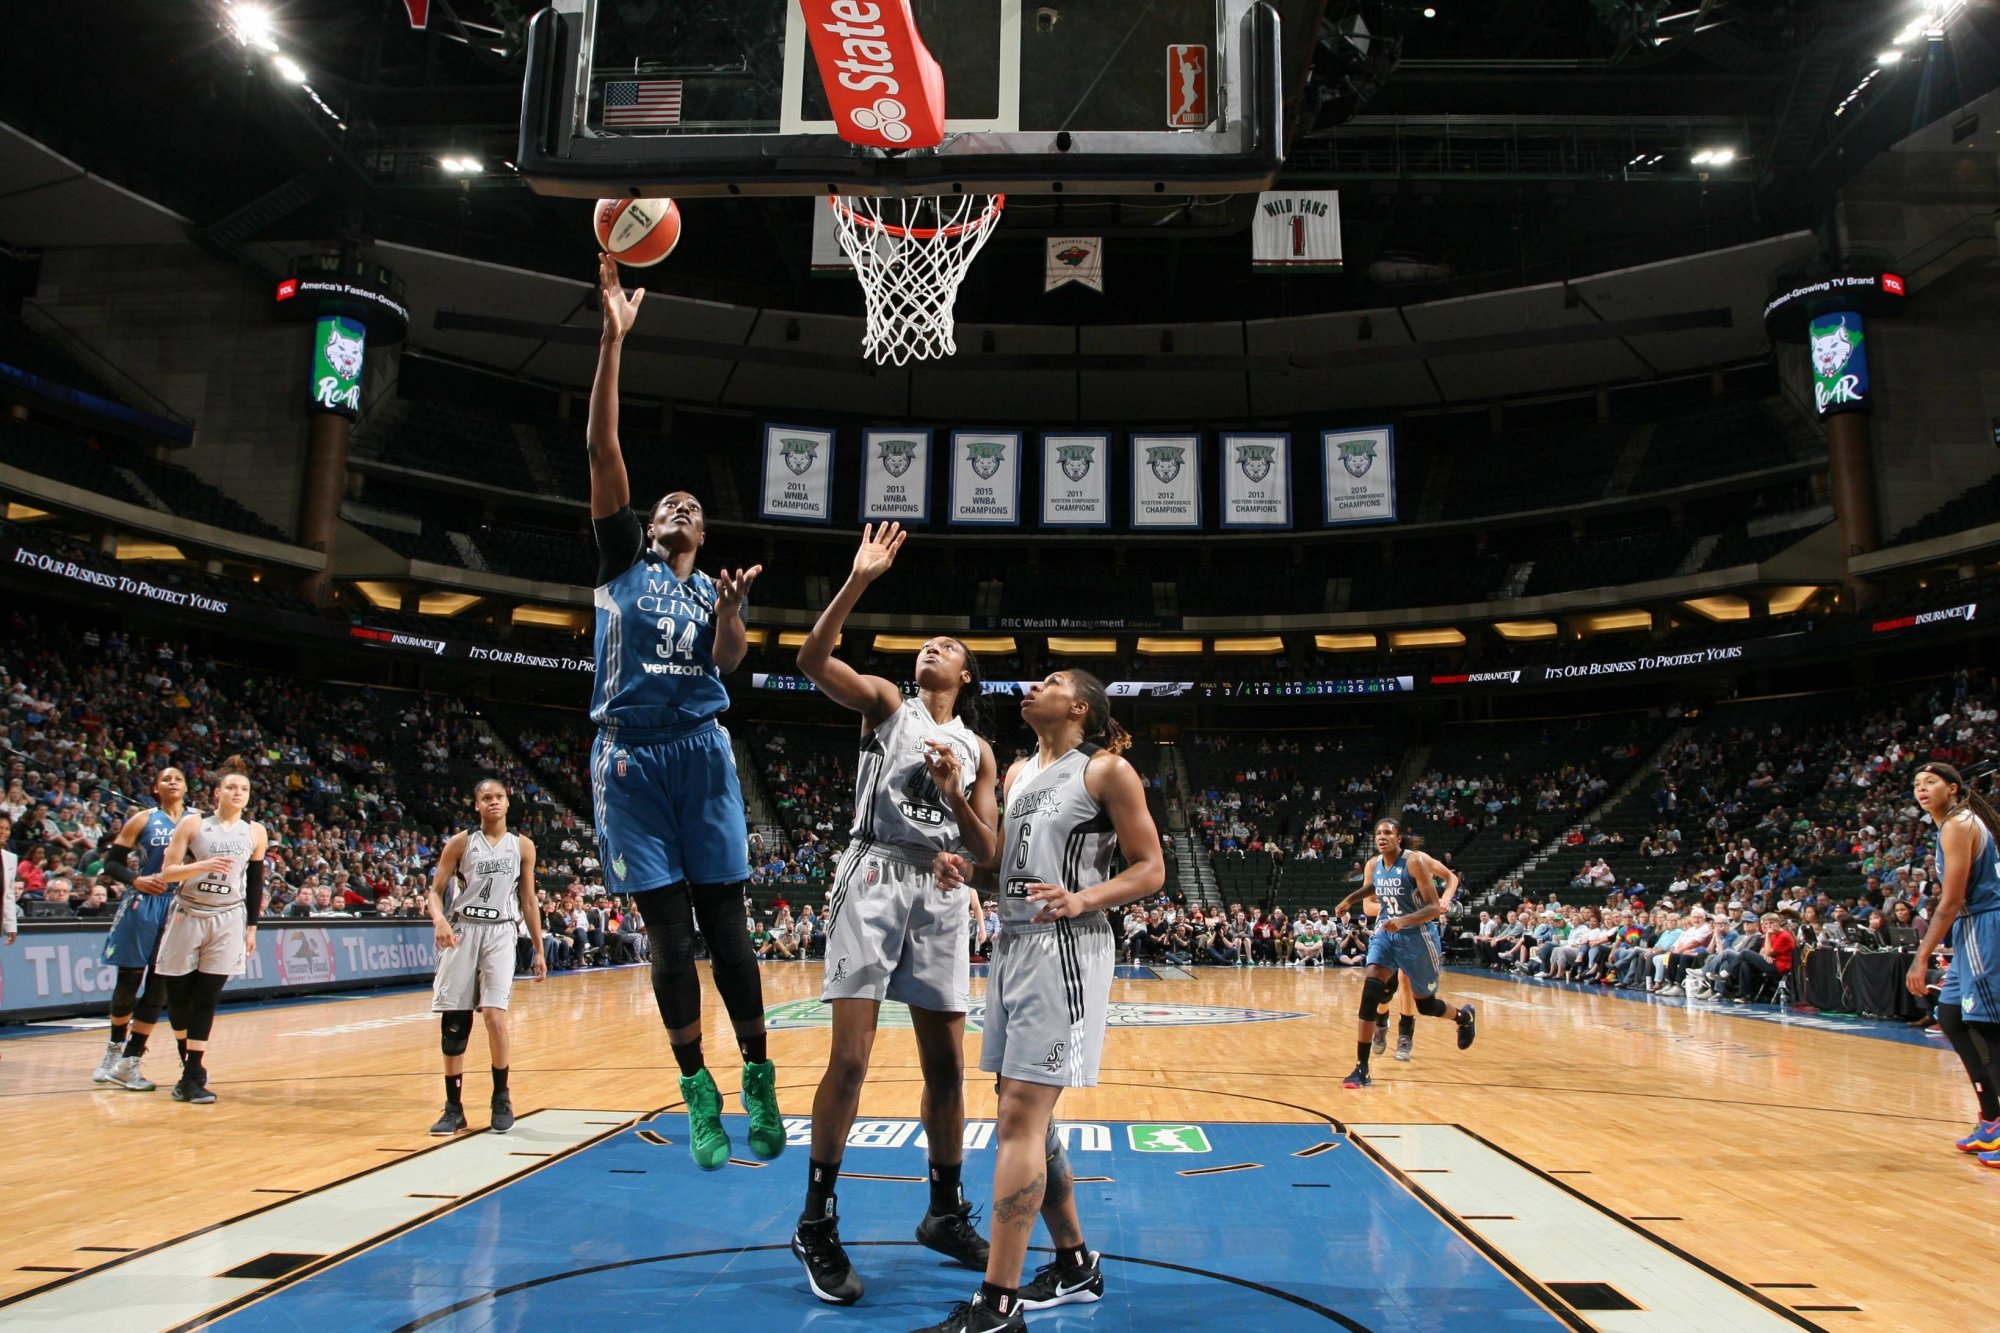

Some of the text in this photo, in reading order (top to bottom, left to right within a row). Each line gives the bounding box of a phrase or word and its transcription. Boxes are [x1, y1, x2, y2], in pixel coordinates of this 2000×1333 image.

[821, 0, 900, 95] State
[1263, 198, 1328, 218] WILD FANS
[1289, 215, 1306, 256] 1
[1885, 279, 1901, 290] TCL
[279, 285, 293, 296] TCL
[1769, 276, 1875, 310] Fastest-Growing TV Brand
[300, 281, 343, 293] America's
[344, 284, 403, 315] Fastest-Growing
[786, 482, 807, 491] 2011
[886, 485, 905, 494] 2013
[974, 487, 993, 496] 2015
[1350, 486, 1368, 494] 2015
[784, 491, 809, 501] WNBA
[883, 494, 907, 503] WNBA
[1066, 490, 1083, 498] 2011
[1157, 492, 1175, 500] 2012
[1248, 491, 1265, 499] 2013
[771, 499, 820, 512] CHAMPIONS
[972, 496, 996, 505] WNBA
[1339, 499, 1381, 509] CHAMPIONS
[870, 503, 919, 513] CHAMPIONS
[959, 505, 1008, 515] CHAMPIONS
[1054, 504, 1095, 512] CHAMPIONS
[1145, 506, 1187, 514] CHAMPIONS
[1235, 505, 1277, 513] CHAMPIONS
[38, 555, 66, 574] OUR
[64, 562, 117, 588] BUSINESS
[118, 576, 137, 592] TO
[137, 582, 188, 605] PROTECT
[190, 593, 228, 613] YOURS
[646, 578, 697, 602] MAY
[637, 595, 709, 623] CLINI
[1915, 606, 1963, 624] INSURANCE
[1001, 618, 1021, 627] RBC
[1024, 618, 1058, 627] Wealth
[1060, 618, 1124, 629] Management
[391, 634, 435, 649] INSURANCE
[656, 616, 696, 660] 34
[489, 648, 512, 663] OUR
[513, 651, 559, 668] BUSINESS
[561, 657, 577, 670] TO
[1564, 665, 1588, 677] OUR
[1589, 661, 1636, 675] BUSINESS
[1638, 657, 1655, 669] TO
[1655, 651, 1705, 668] PROTECT
[1706, 646, 1742, 660] YOURS
[641, 662, 703, 676] verizon
[1468, 671, 1510, 682] INSURANCE
[778, 681, 784, 689] 0
[786, 682, 795, 690] 12
[905, 686, 919, 694] 3 7
[1117, 685, 1130, 694] 37
[1225, 688, 1230, 696] 3
[1306, 686, 1316, 694] 20
[1358, 684, 1363, 692] 5
[1010, 787, 1061, 819] STARS
[1016, 823, 1031, 869] 6
[1377, 878, 1401, 887] MAYO
[479, 877, 493, 903] 4
[1375, 886, 1405, 896] CLINIC
[1382, 896, 1403, 915] 32
